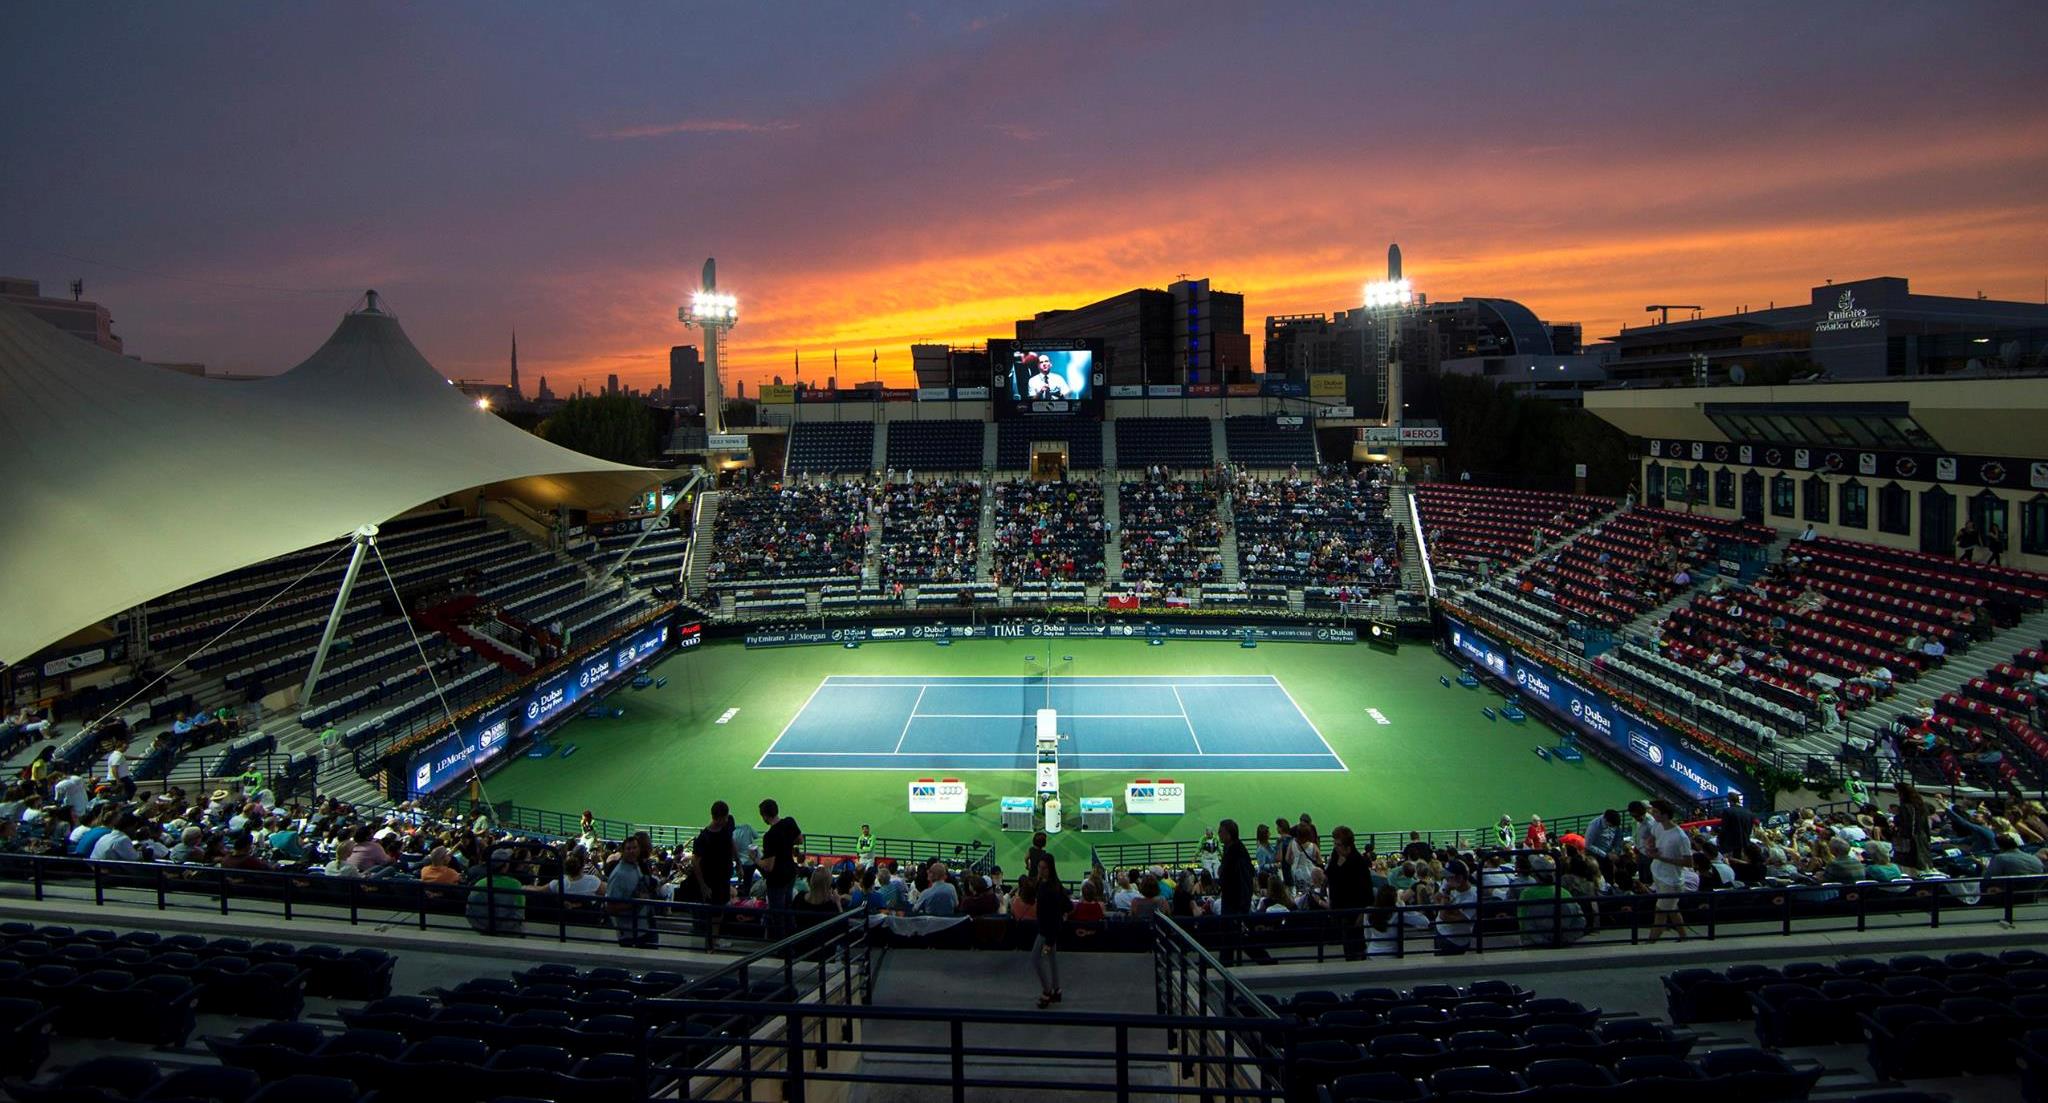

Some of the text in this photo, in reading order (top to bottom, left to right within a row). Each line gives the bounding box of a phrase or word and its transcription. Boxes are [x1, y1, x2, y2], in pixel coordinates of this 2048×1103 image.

[1827, 308, 1867, 320] Emirates
[1815, 318, 1881, 332] Aviation College
[1412, 429, 1439, 439] EROS
[681, 624, 702, 635] Audi
[992, 625, 1025, 636] TIME
[746, 635, 785, 644] Fly Emirates
[788, 633, 826, 642] J.P.Morgan
[590, 661, 609, 677] Dubai
[590, 669, 609, 684] Duty Free
[1528, 673, 1550, 692] Dubai
[540, 688, 563, 705] Dubai
[1527, 683, 1550, 700] Duty Free
[540, 696, 563, 713] Duty Free
[1618, 706, 1634, 718] Dubai
[1584, 704, 1610, 728] Dubai
[1584, 715, 1611, 736] Duty Free
[418, 743, 435, 754] Dubai
[1689, 744, 1708, 758] Dubai
[1708, 754, 1724, 767] Duty
[435, 744, 475, 773] J.P.Morgan
[1669, 759, 1719, 795] J.P.Morgan
